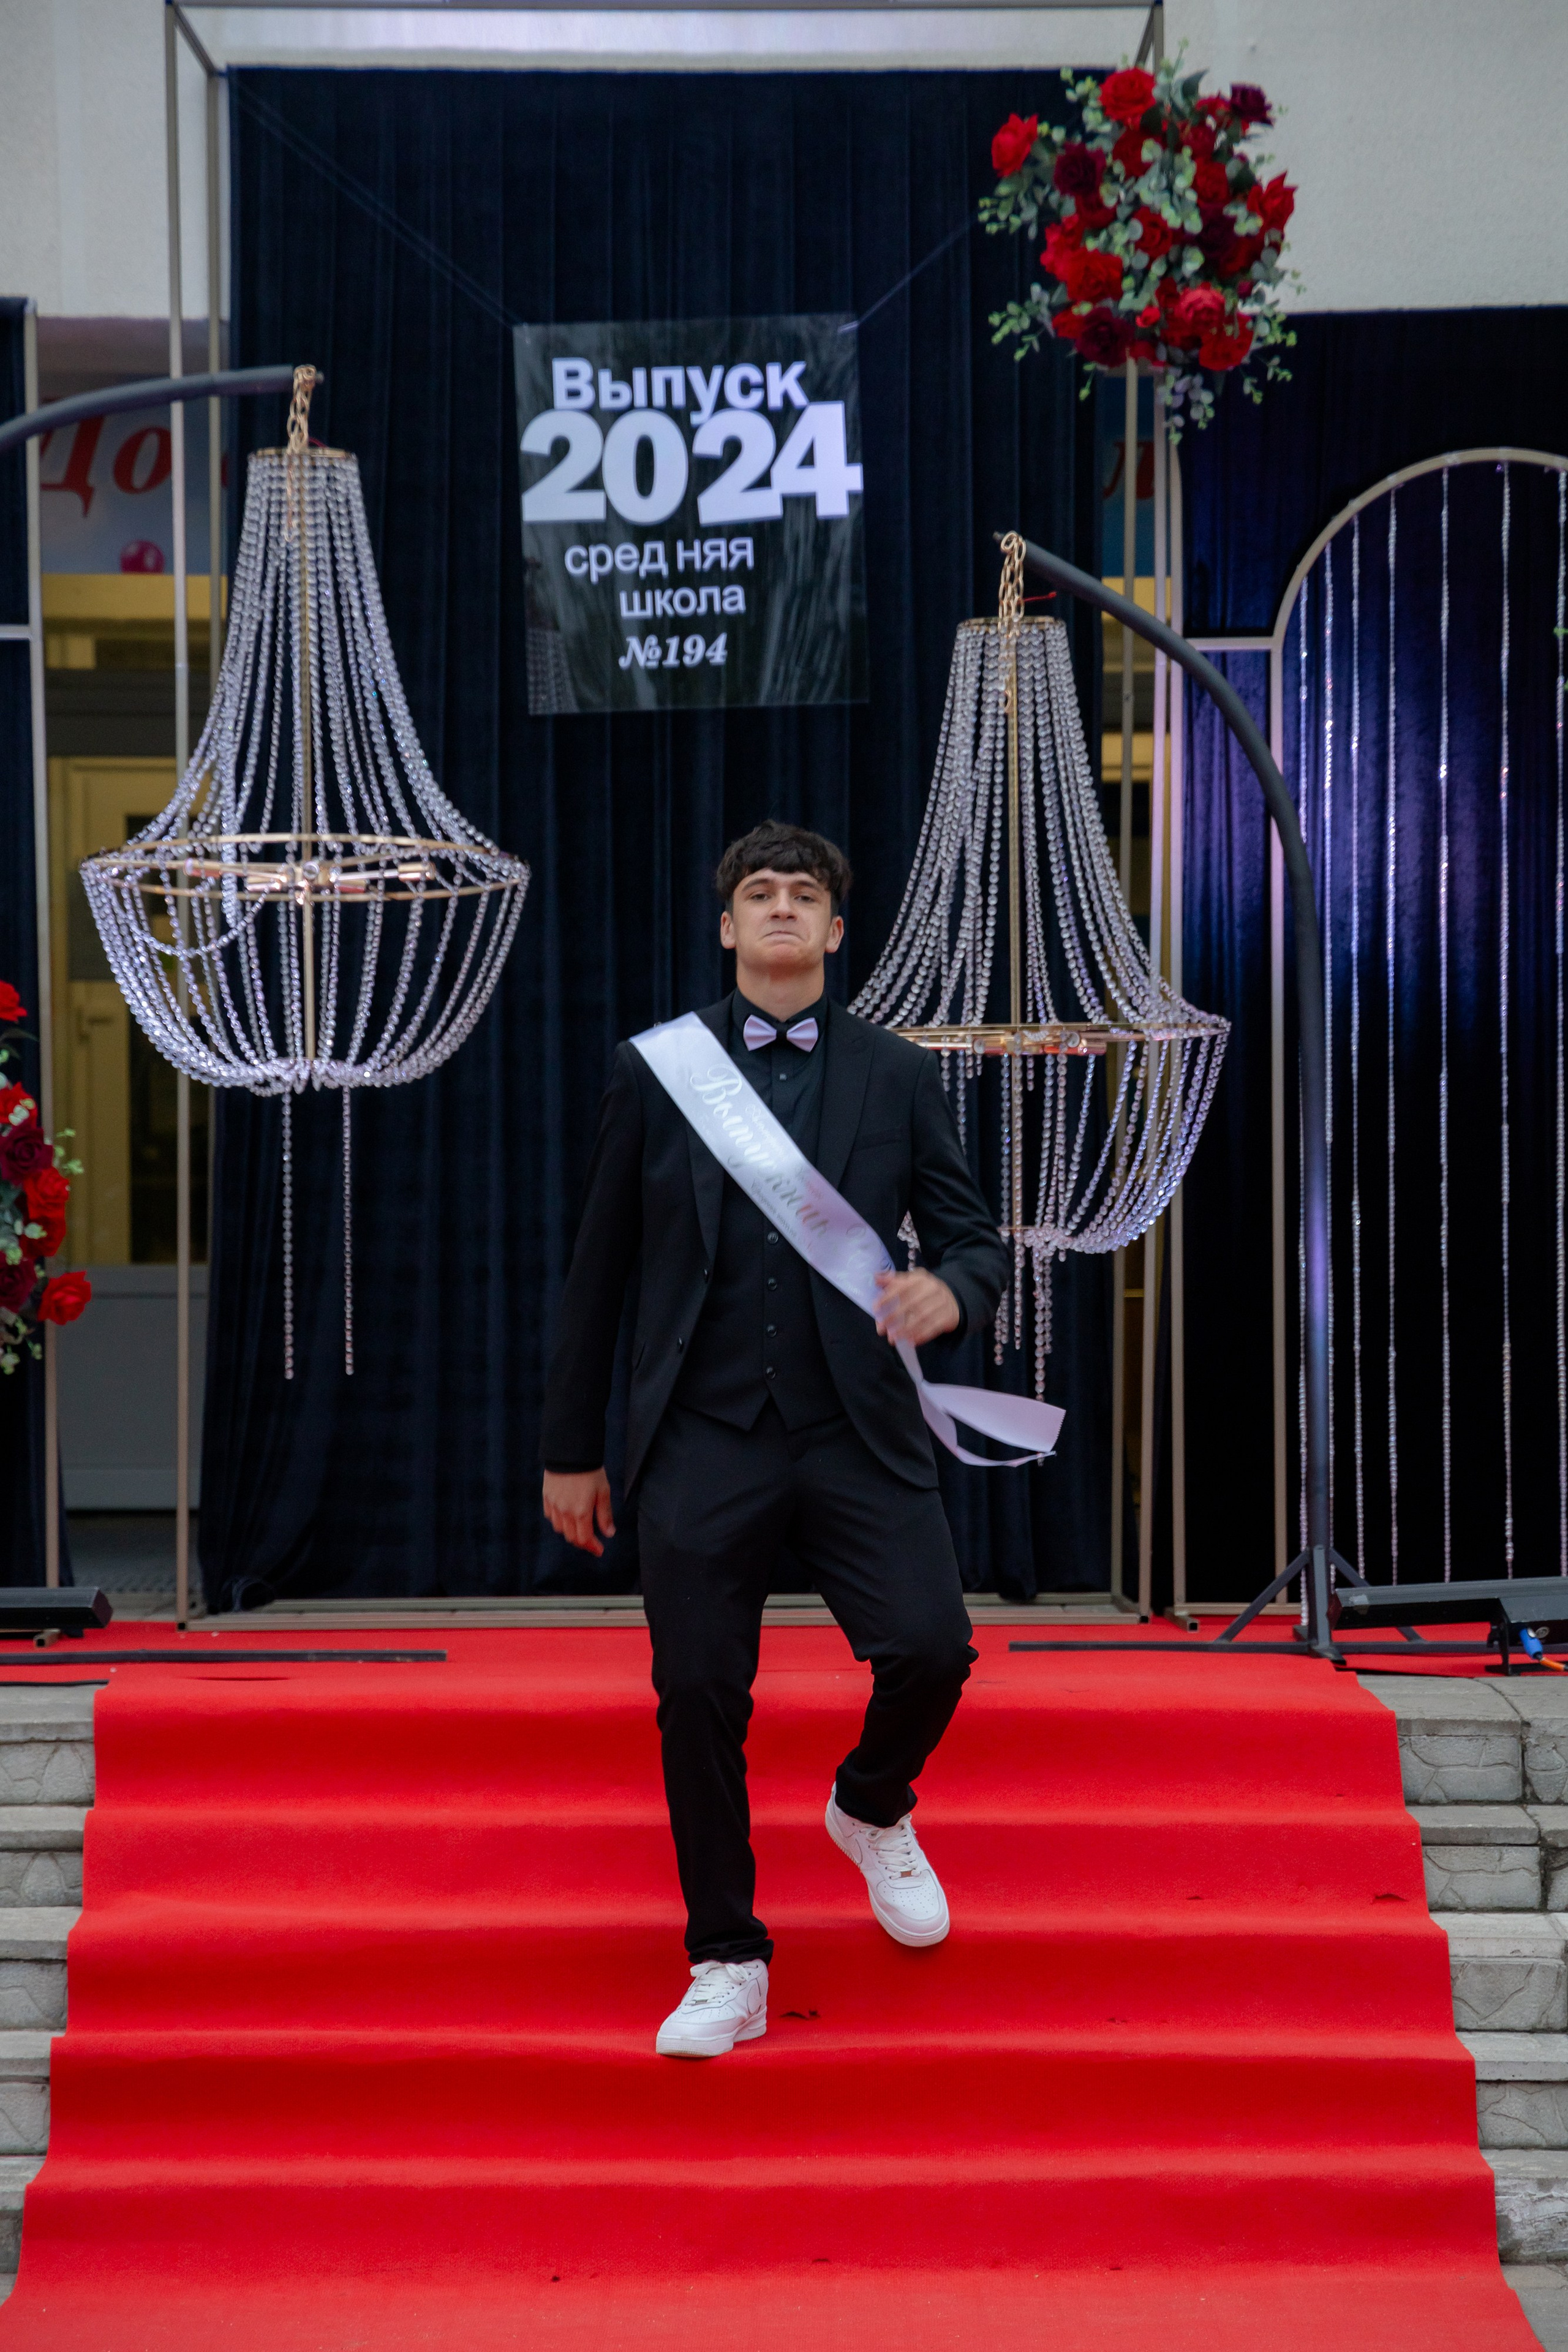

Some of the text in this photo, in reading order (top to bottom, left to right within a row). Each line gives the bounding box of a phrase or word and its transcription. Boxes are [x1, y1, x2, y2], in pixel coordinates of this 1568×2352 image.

[552, 357, 807, 426] Выпуск
[520, 401, 863, 527] 2024
[619, 584, 746, 619] школа
[619, 633, 728, 668] №194
